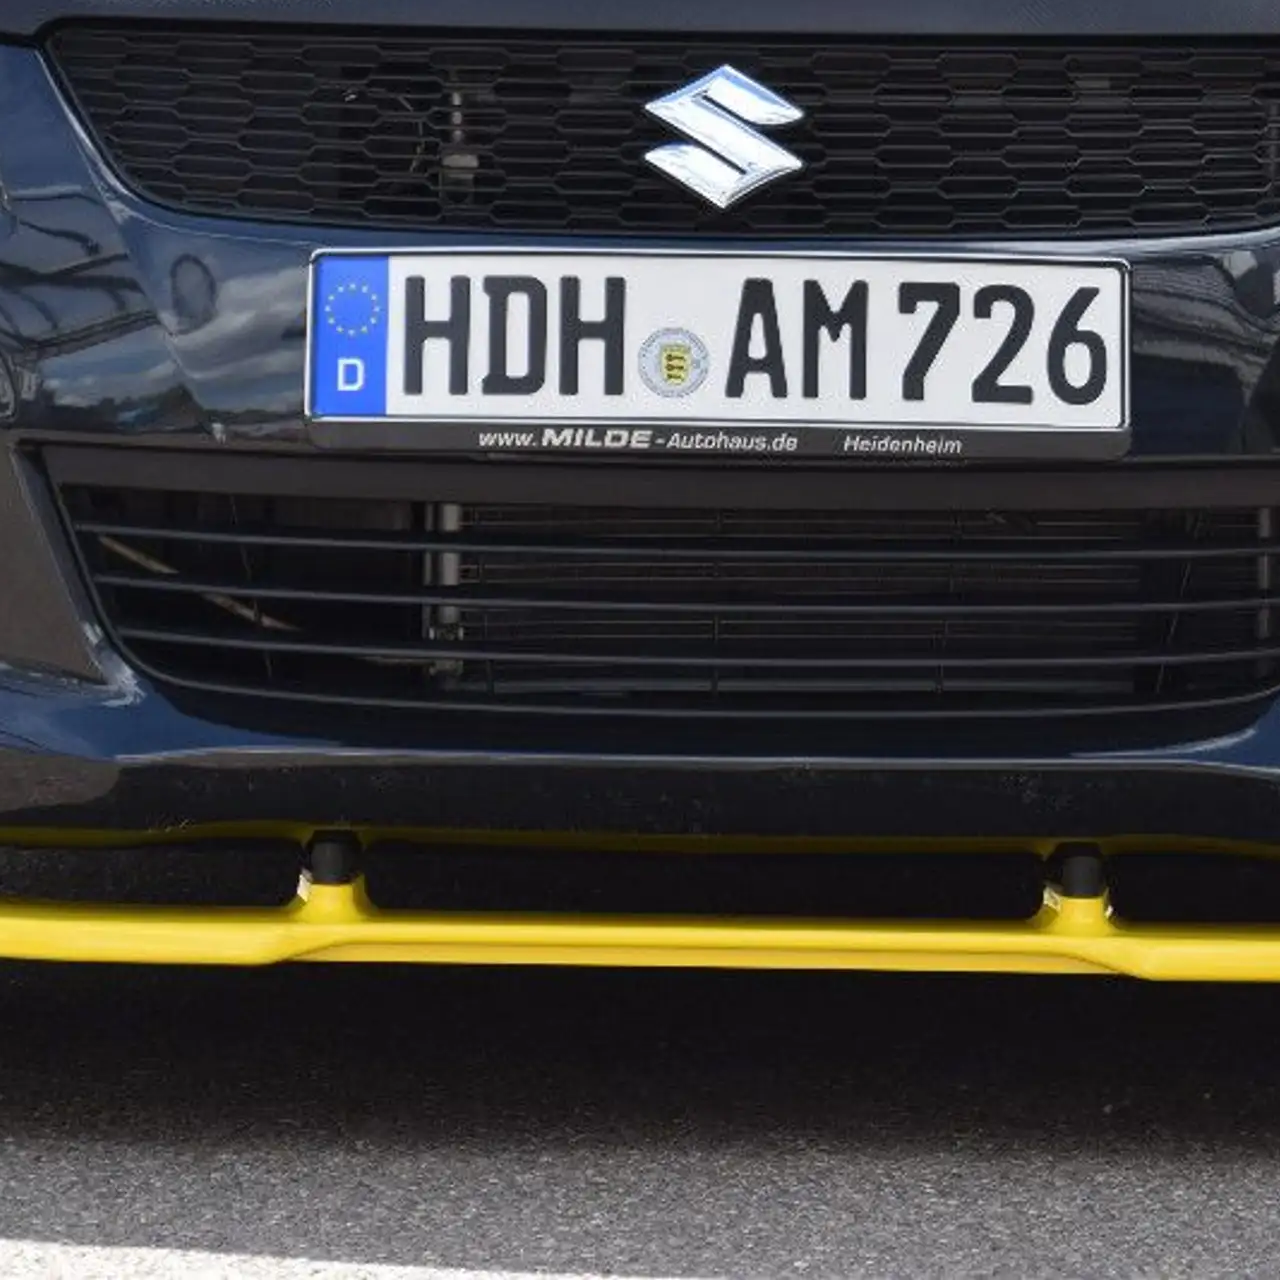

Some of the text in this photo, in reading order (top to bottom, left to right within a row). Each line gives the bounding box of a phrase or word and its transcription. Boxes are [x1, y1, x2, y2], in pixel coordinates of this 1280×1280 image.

[405, 277, 626, 396] HDH
[337, 357, 365, 392] D
[842, 433, 963, 454] Heidenheim
